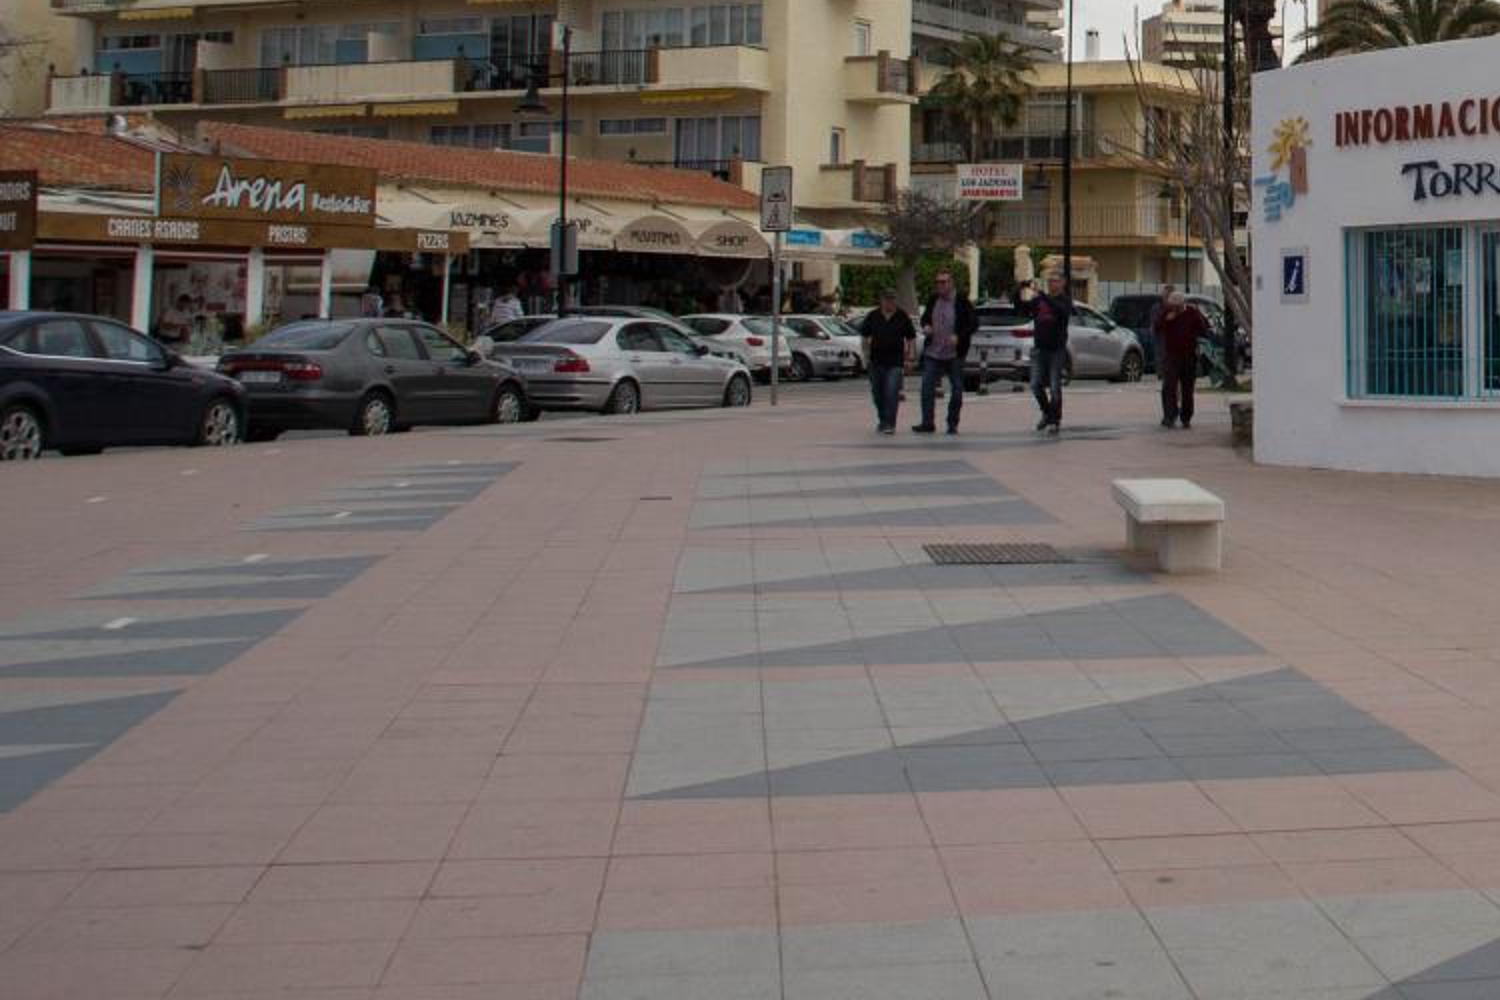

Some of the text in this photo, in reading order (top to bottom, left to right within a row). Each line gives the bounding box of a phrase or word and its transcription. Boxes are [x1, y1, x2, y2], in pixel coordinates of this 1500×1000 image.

[971, 167, 1008, 177] HOTEL
[202, 164, 305, 213] Arena
[108, 218, 152, 238] CARNES
[416, 232, 449, 249] PIZZAS
